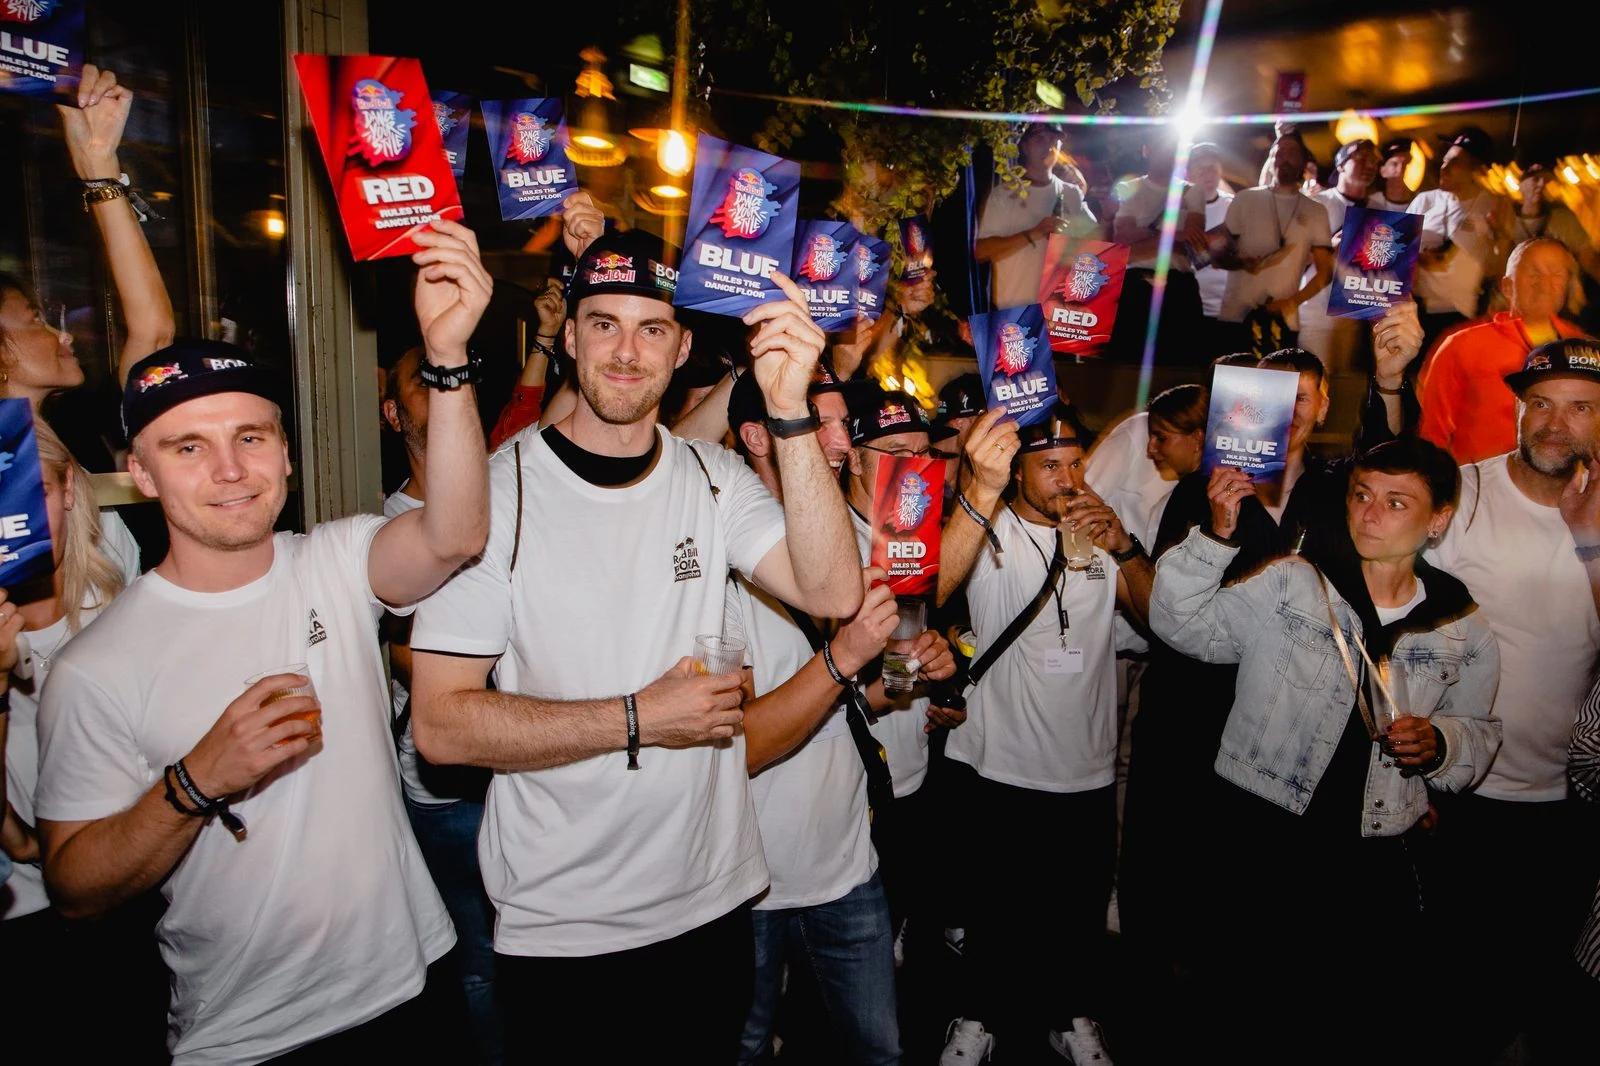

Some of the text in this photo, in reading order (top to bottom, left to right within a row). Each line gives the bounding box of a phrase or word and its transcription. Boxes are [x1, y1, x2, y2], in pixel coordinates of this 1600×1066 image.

[0, 31, 69, 67] LUE
[0, 63, 57, 82] NCE FLOOR
[29, 62, 50, 72] THE
[507, 169, 567, 188] BLUE
[362, 175, 435, 204] RED
[733, 192, 763, 207] DANCE
[379, 205, 433, 218] RULES THE
[736, 205, 763, 219] YOUR
[375, 217, 410, 229] DANCE
[732, 215, 760, 234] STYLE
[699, 243, 779, 279] BLUE
[589, 270, 611, 285] Red
[611, 269, 636, 283] Bull
[713, 273, 761, 289] RULES THE
[704, 281, 766, 299] DANCE FLOOR
[1070, 288, 1093, 299] STYLE
[1344, 276, 1403, 295] BLUE
[858, 291, 878, 307] UE
[1370, 300, 1392, 308] FLOOR
[1052, 308, 1098, 327] RED
[1050, 331, 1092, 341] DANCE FLOOR
[1568, 355, 1600, 367] BOR
[996, 377, 1048, 401] BLUE
[1007, 403, 1043, 414] DANCE FLOOR
[1010, 399, 1028, 407] RULES
[1216, 435, 1277, 456] BLUE
[1221, 459, 1265, 469] DANCE FLOOR
[673, 549, 687, 564] Rd
[888, 541, 927, 558] RED
[674, 559, 700, 575] BOA
[628, 710, 636, 737] cooking
[179, 770, 189, 787] than
